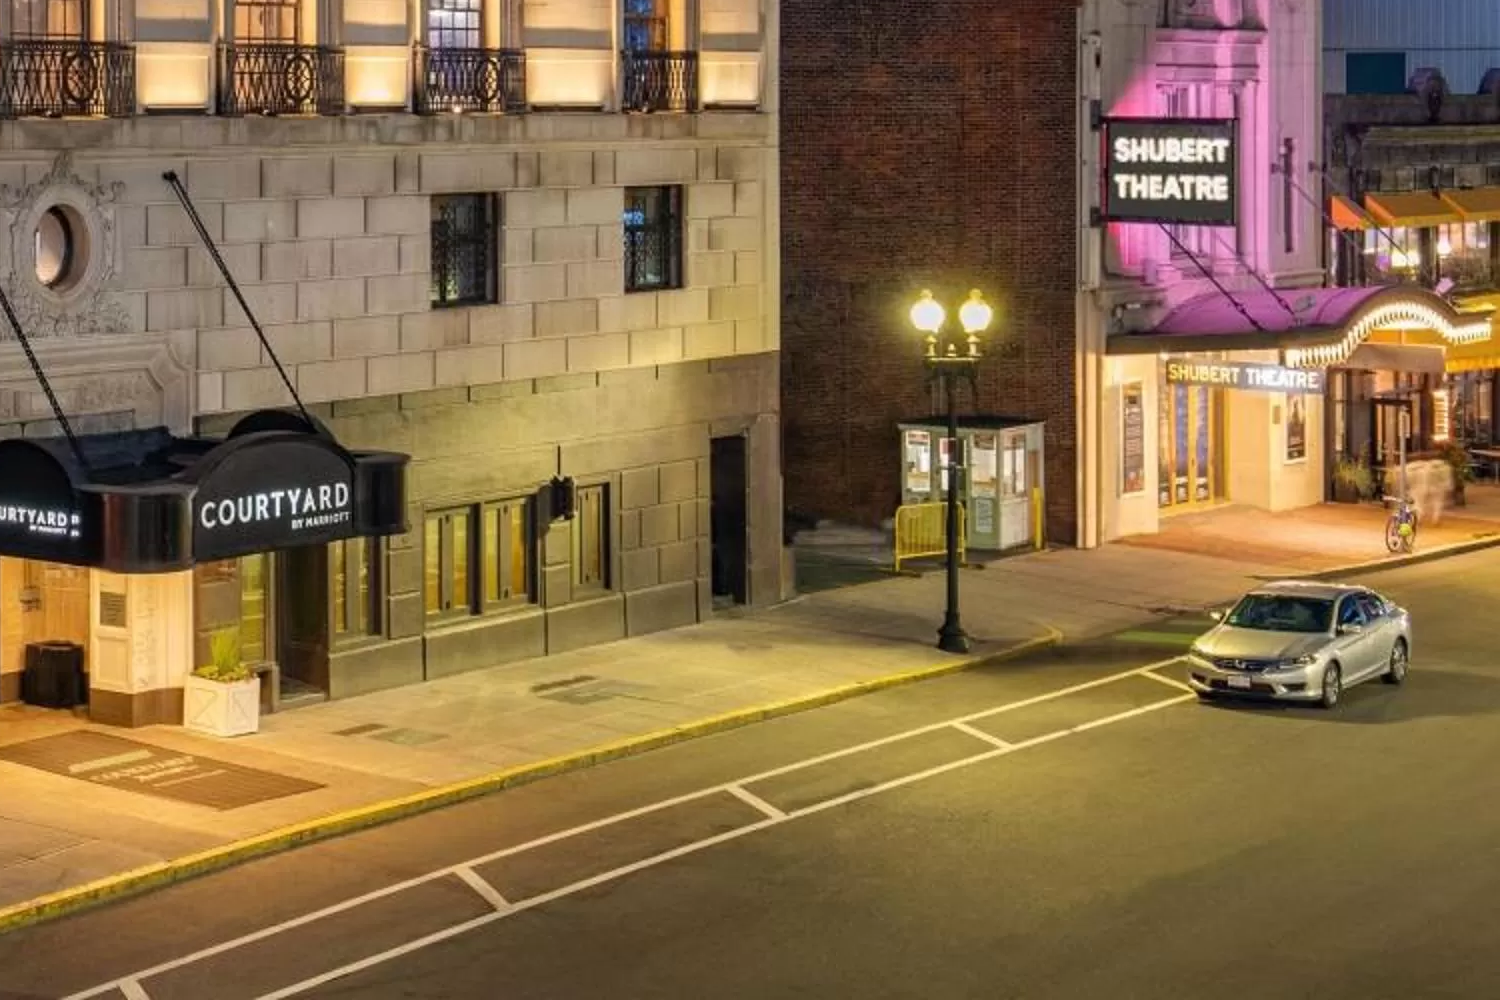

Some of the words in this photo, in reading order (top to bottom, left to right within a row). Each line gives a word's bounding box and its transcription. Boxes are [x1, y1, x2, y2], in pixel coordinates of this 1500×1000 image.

[1114, 137, 1230, 163] SHUBERT
[1114, 174, 1229, 201] THEATRE
[1168, 363, 1240, 384] SHUBERT
[1245, 367, 1320, 389] THEATRE
[201, 483, 349, 528] COURTYARD
[291, 518, 303, 530] BY
[305, 511, 350, 527] MARRIOTT
